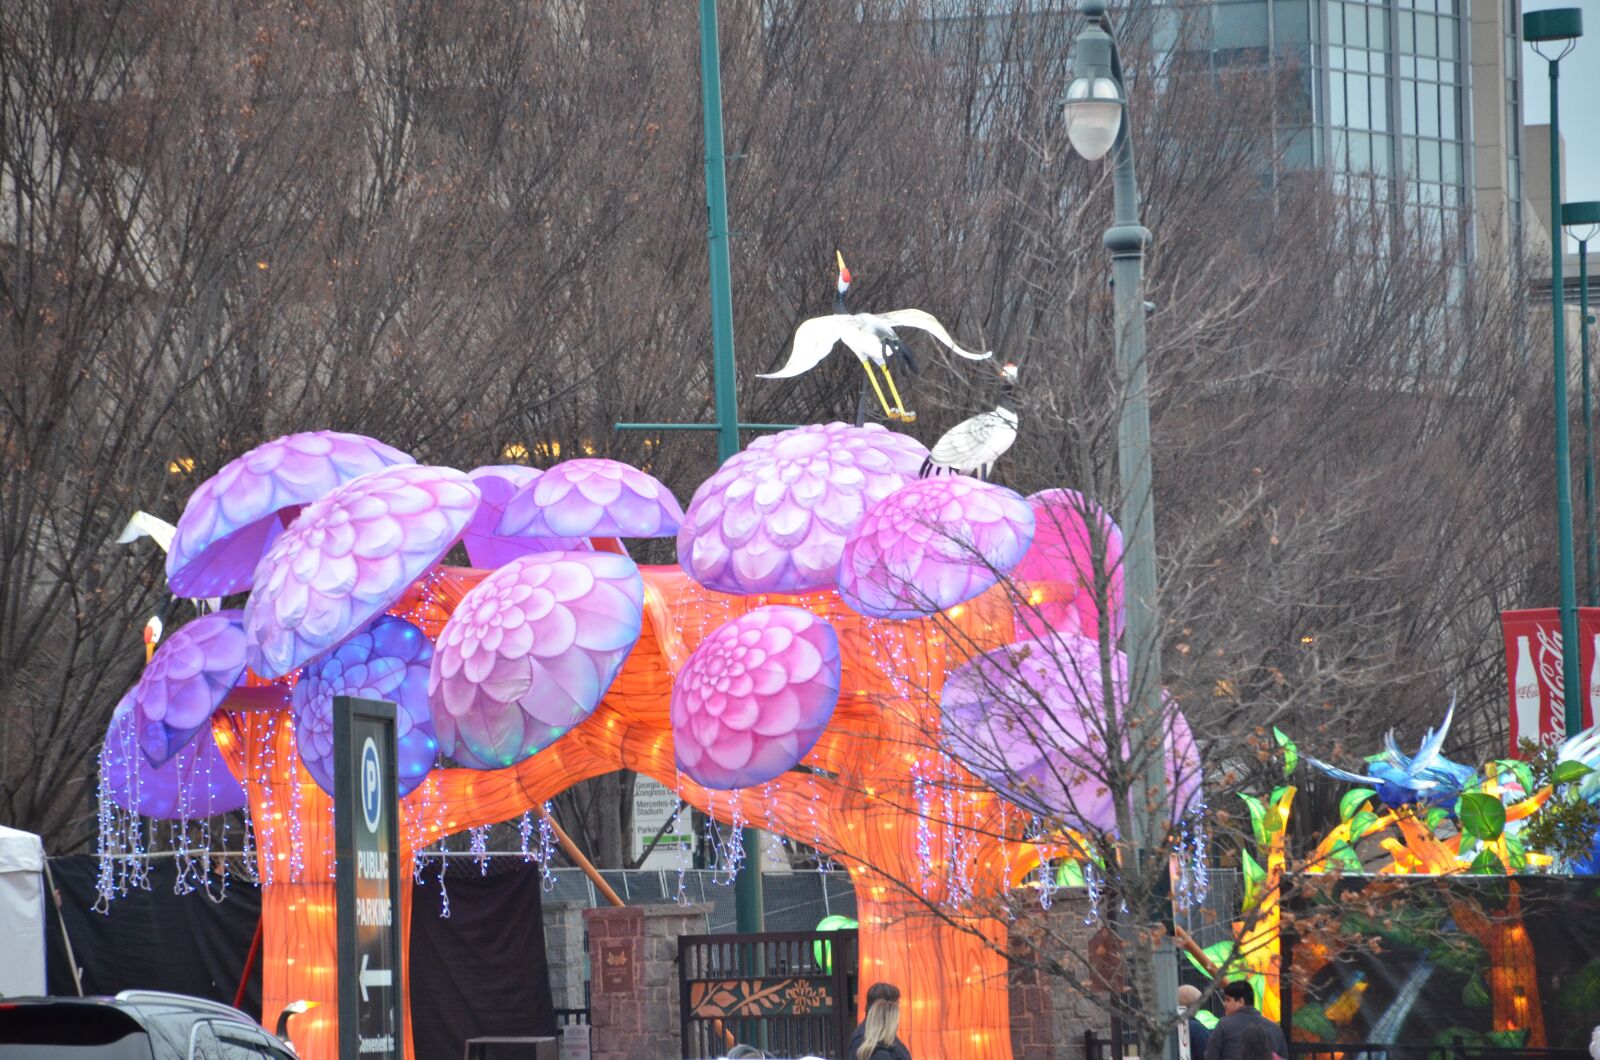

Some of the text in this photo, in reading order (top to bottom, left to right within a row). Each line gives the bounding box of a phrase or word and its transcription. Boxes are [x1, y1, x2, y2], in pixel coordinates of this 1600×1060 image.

[366, 760, 377, 811] P
[357, 850, 388, 880] PUBLIC
[356, 898, 392, 927] PARKING
